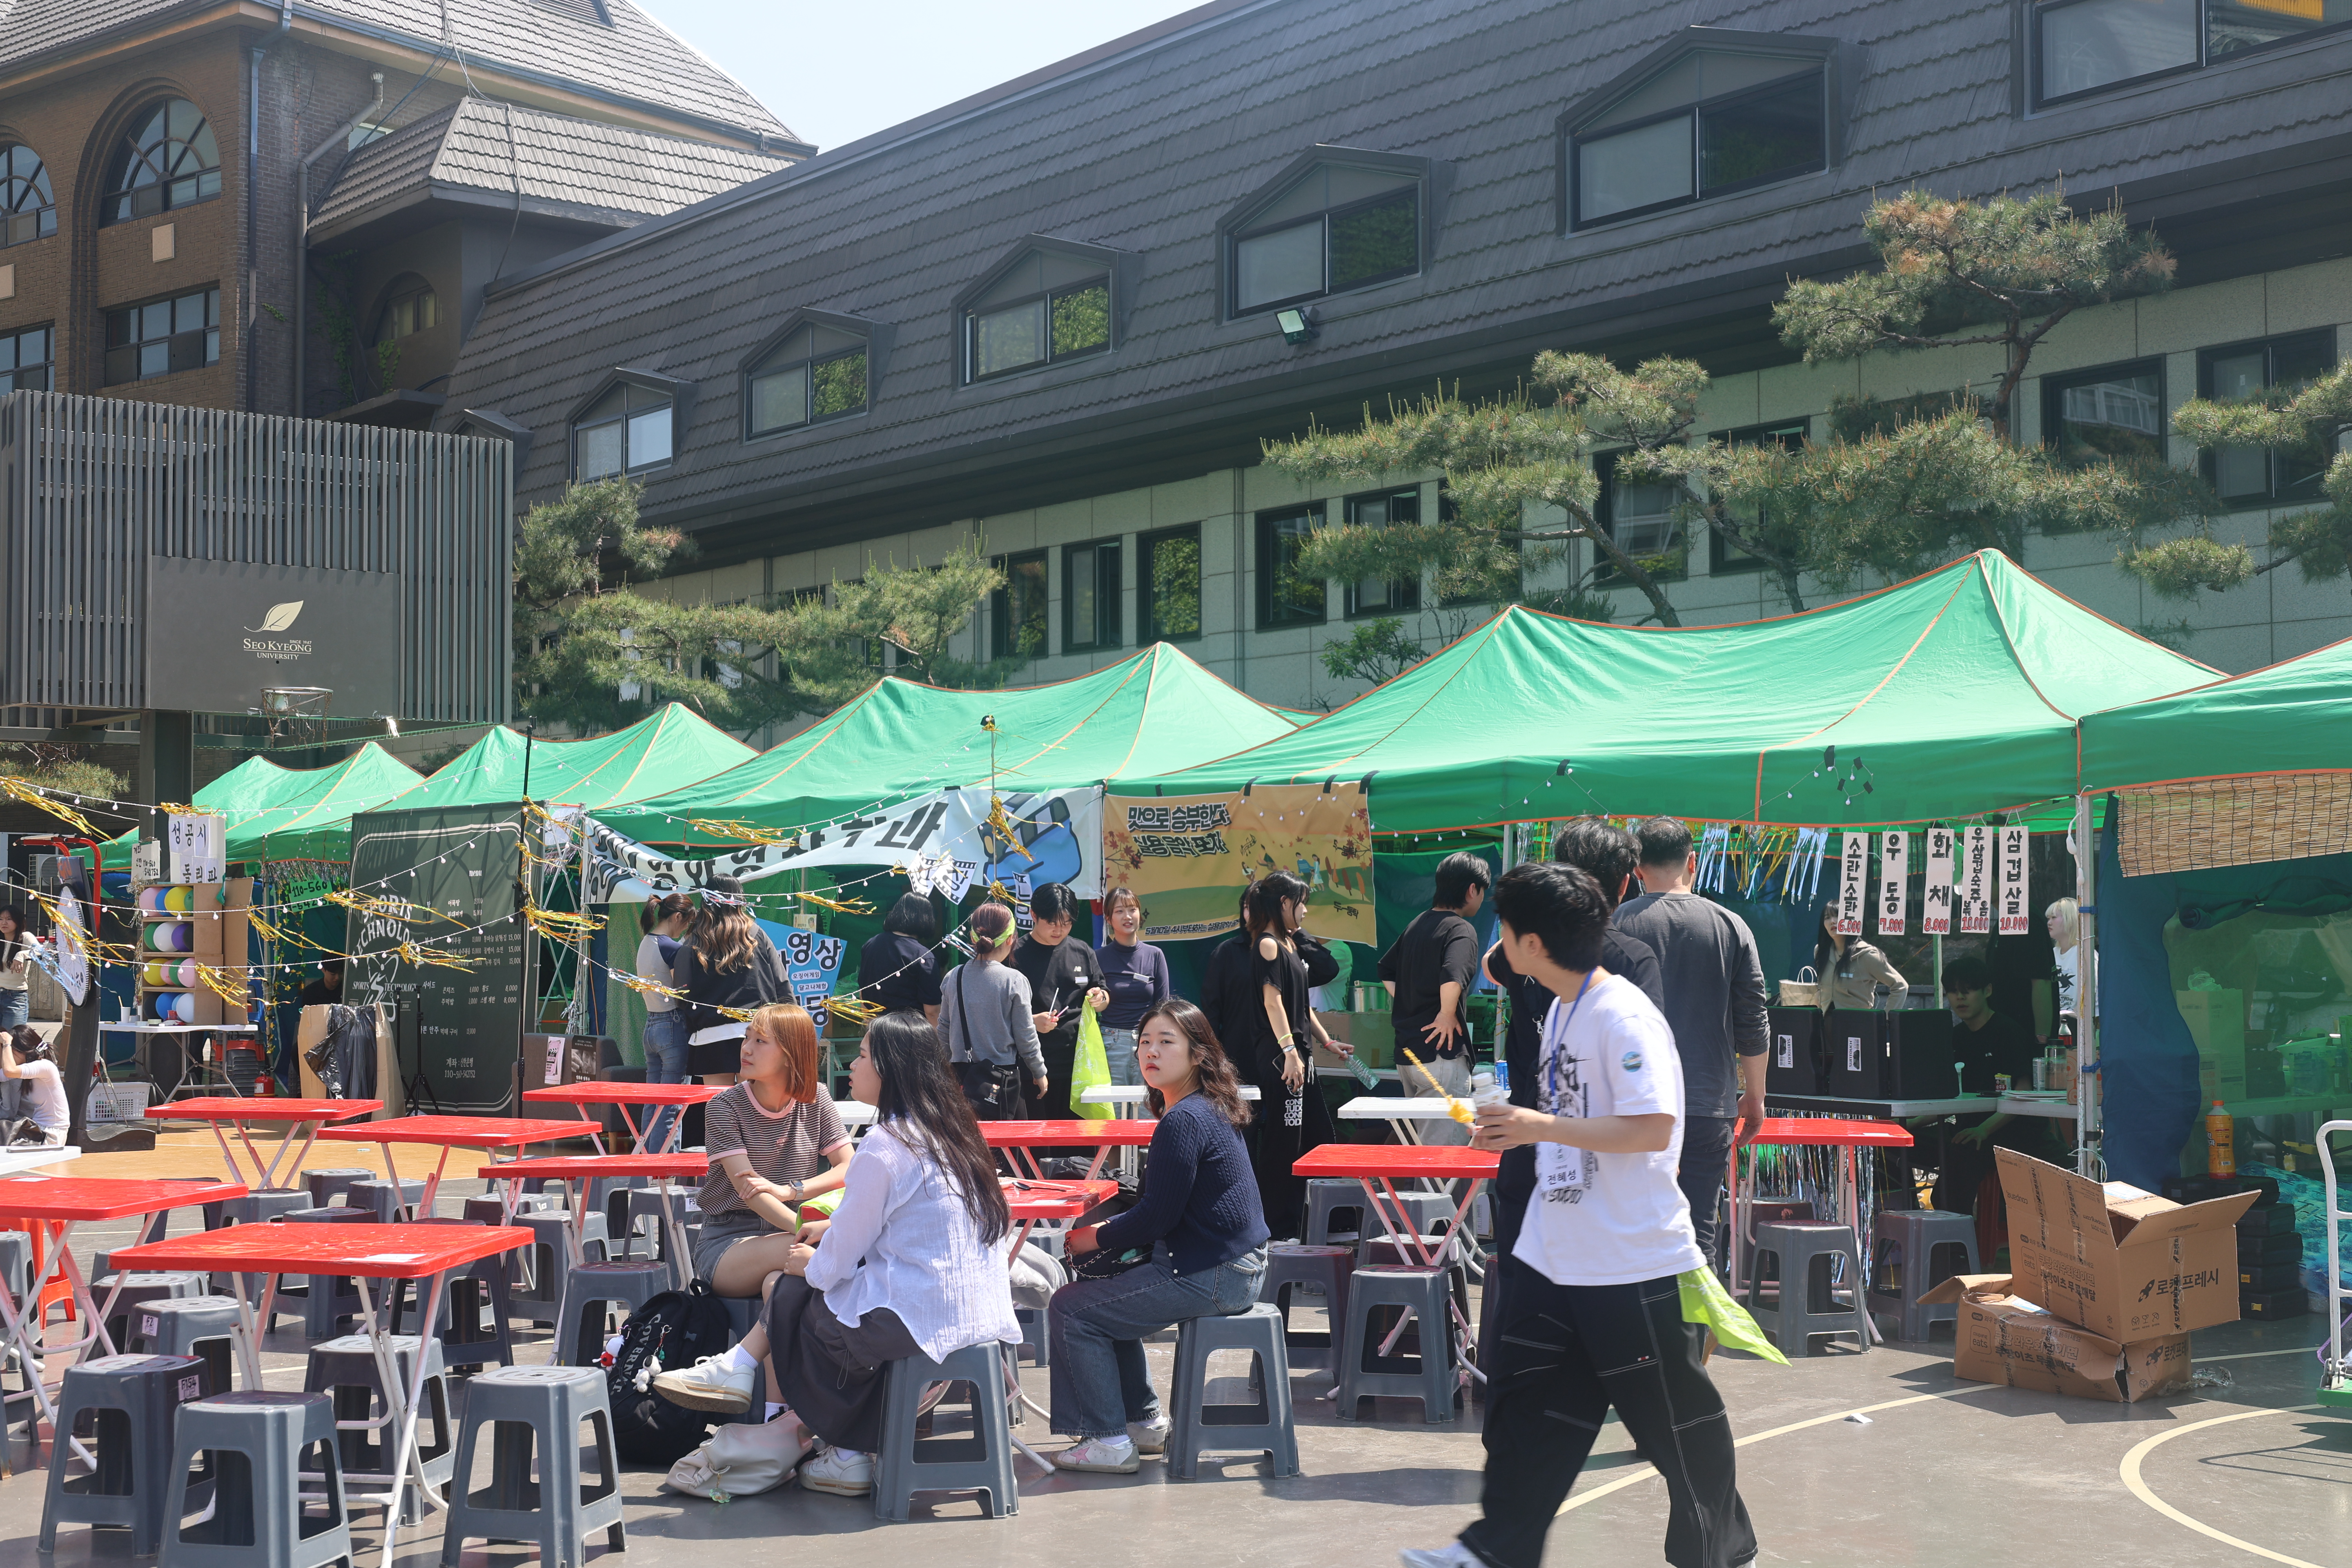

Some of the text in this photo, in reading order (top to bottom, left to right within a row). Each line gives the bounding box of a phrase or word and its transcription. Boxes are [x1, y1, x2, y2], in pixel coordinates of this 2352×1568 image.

[243, 638, 312, 652] SEO KYEONG
[1127, 806, 1171, 833] 맛으로
[171, 820, 207, 848] 성공시
[1885, 834, 1901, 915] 우동
[1928, 831, 1952, 907] 화채
[2005, 830, 2022, 915] 삼겹살
[1844, 837, 1862, 920] 소란소란
[292, 880, 328, 897] 110-560
[362, 894, 412, 923] SPORTS
[1838, 918, 1861, 933] 6,000
[1879, 918, 1904, 932] 7,000
[1924, 917, 1949, 932] 8,000
[2000, 916, 2028, 931] 10,000
[350, 918, 425, 969] TECHNOLO
[352, 981, 370, 990] SPORTS
[422, 981, 436, 989] 사이드
[429, 1026, 439, 1034] 안주
[446, 1058, 457, 1068] 계좌
[2006, 1190, 2028, 1205] coupang
[2083, 1214, 2107, 1227] coupang.com
[2024, 1259, 2036, 1270] eats
[2038, 1253, 2096, 1287] 쿠팡 와우회원이면
[2156, 1268, 2219, 1295] 로켓프레시
[147, 1316, 153, 1327] F2
[1984, 1316, 1993, 1324] 와우
[1973, 1331, 1988, 1339] coupang
[1972, 1338, 1988, 1348] eats
[181, 1376, 196, 1390] F154
